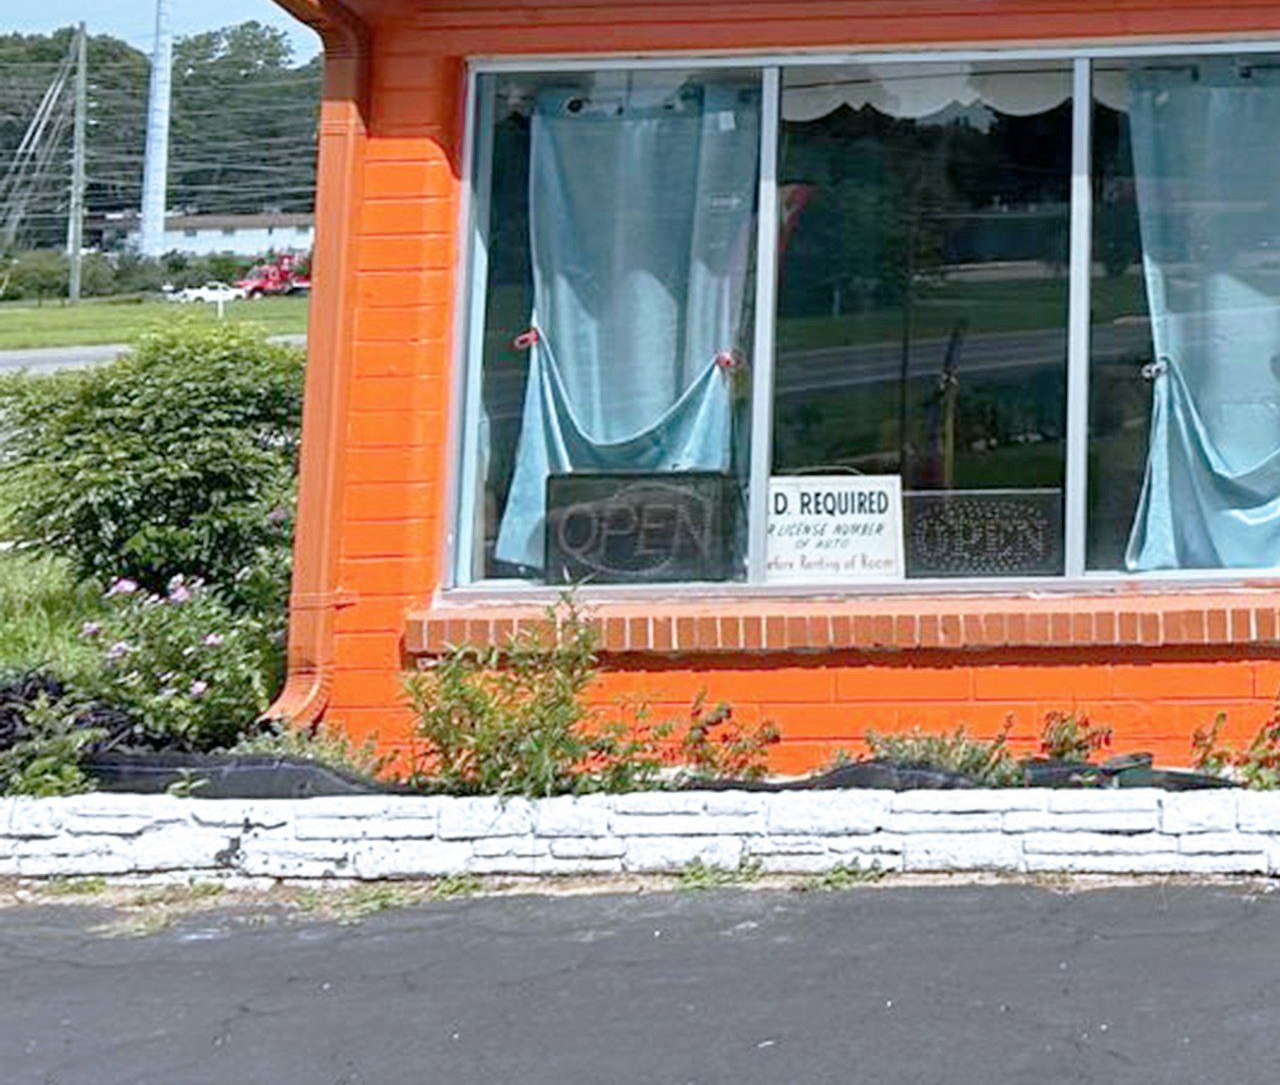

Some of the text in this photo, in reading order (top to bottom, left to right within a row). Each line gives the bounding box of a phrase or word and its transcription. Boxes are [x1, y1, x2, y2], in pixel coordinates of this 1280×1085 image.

[800, 491, 889, 516] REQUIRED
[558, 502, 713, 559] OPEN
[777, 522, 828, 536] LICENSE
[832, 522, 884, 536] NUMBER
[914, 517, 1049, 557] OPEN
[815, 538, 850, 549] AUTO
[766, 556, 793, 570] efore
[844, 555, 857, 569] of
[861, 553, 893, 570] Room
